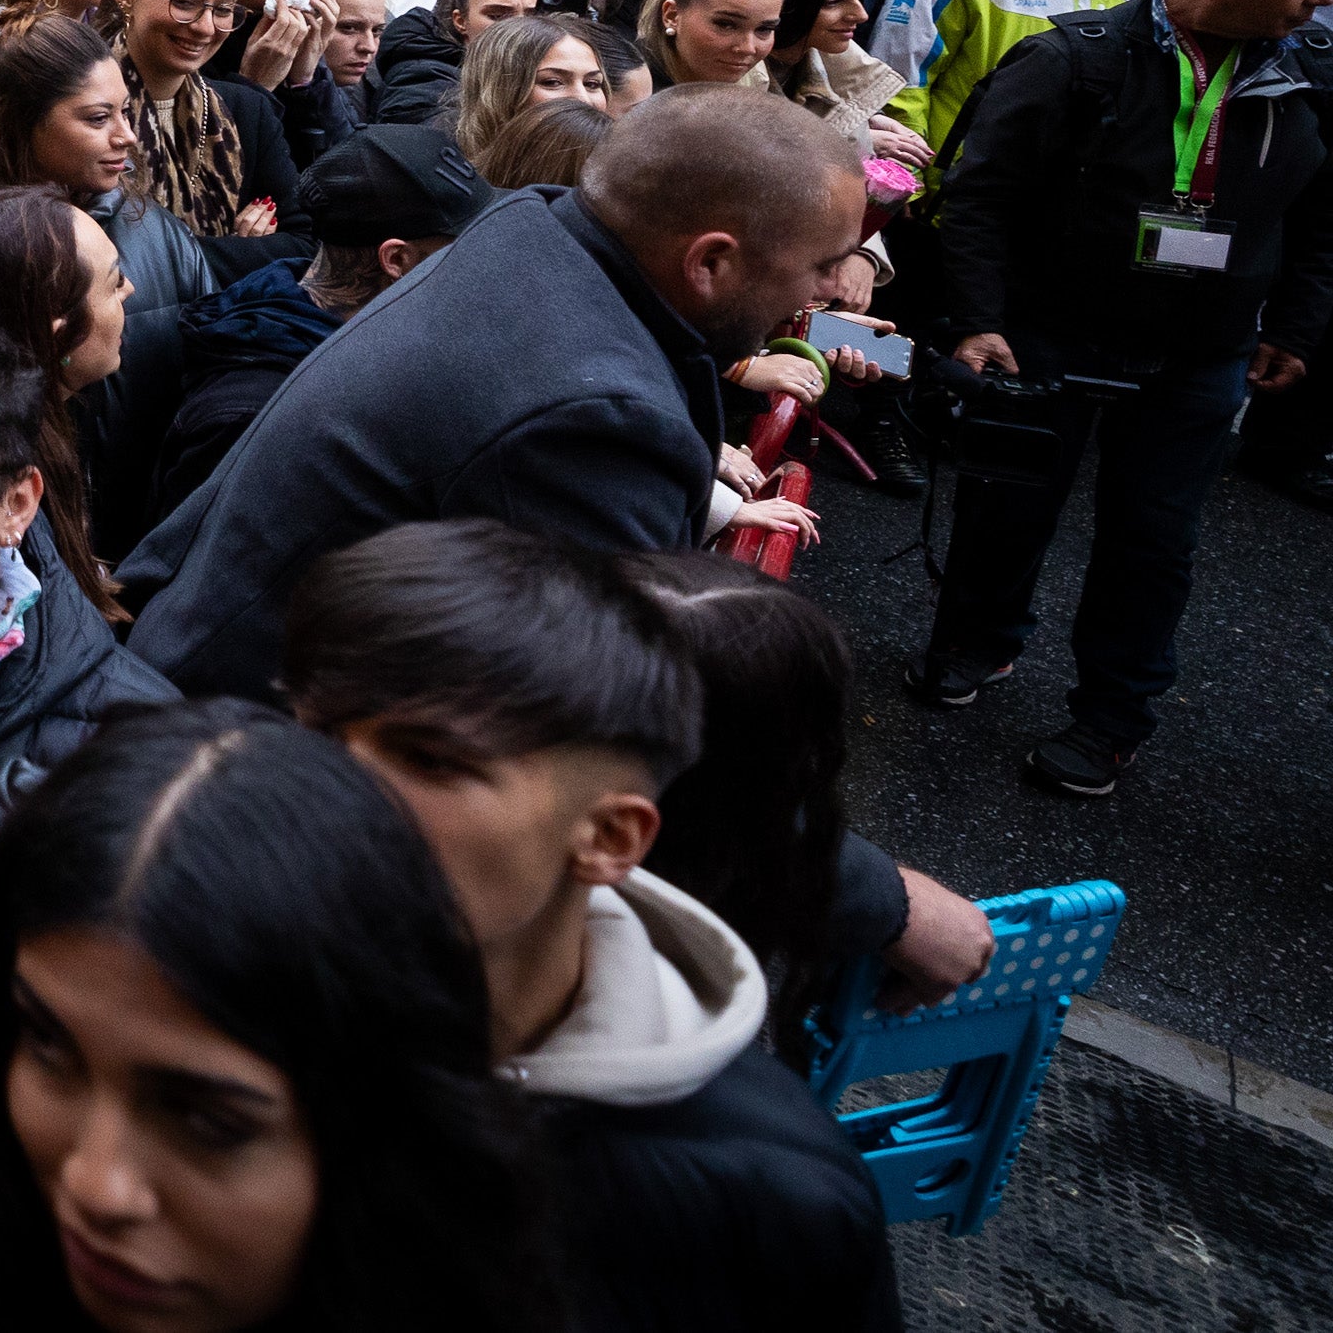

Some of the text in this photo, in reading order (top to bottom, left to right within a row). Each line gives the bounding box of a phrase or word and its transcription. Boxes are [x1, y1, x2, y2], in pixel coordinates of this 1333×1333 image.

[1204, 109, 1221, 165] REAL FEDERACION
[434, 146, 477, 197] IC
